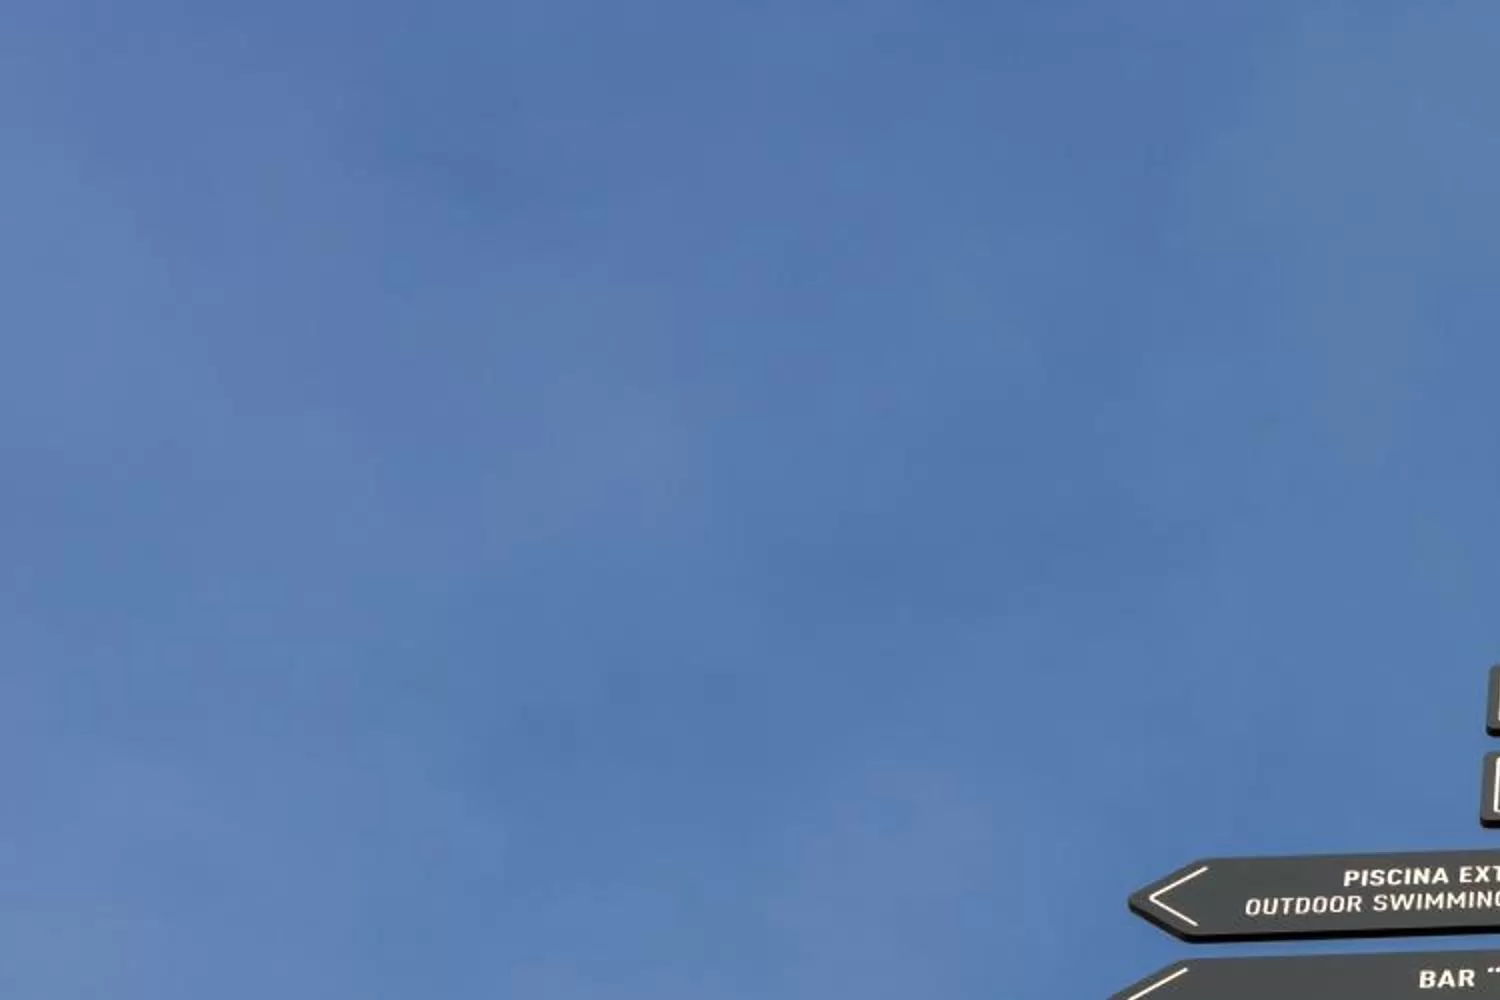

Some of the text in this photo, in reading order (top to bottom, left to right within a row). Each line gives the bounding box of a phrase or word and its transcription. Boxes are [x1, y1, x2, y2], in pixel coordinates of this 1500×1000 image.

[1343, 866, 1450, 888] PISCINA
[1245, 895, 1363, 917] OUTDOOR
[1419, 968, 1476, 989] BAR
